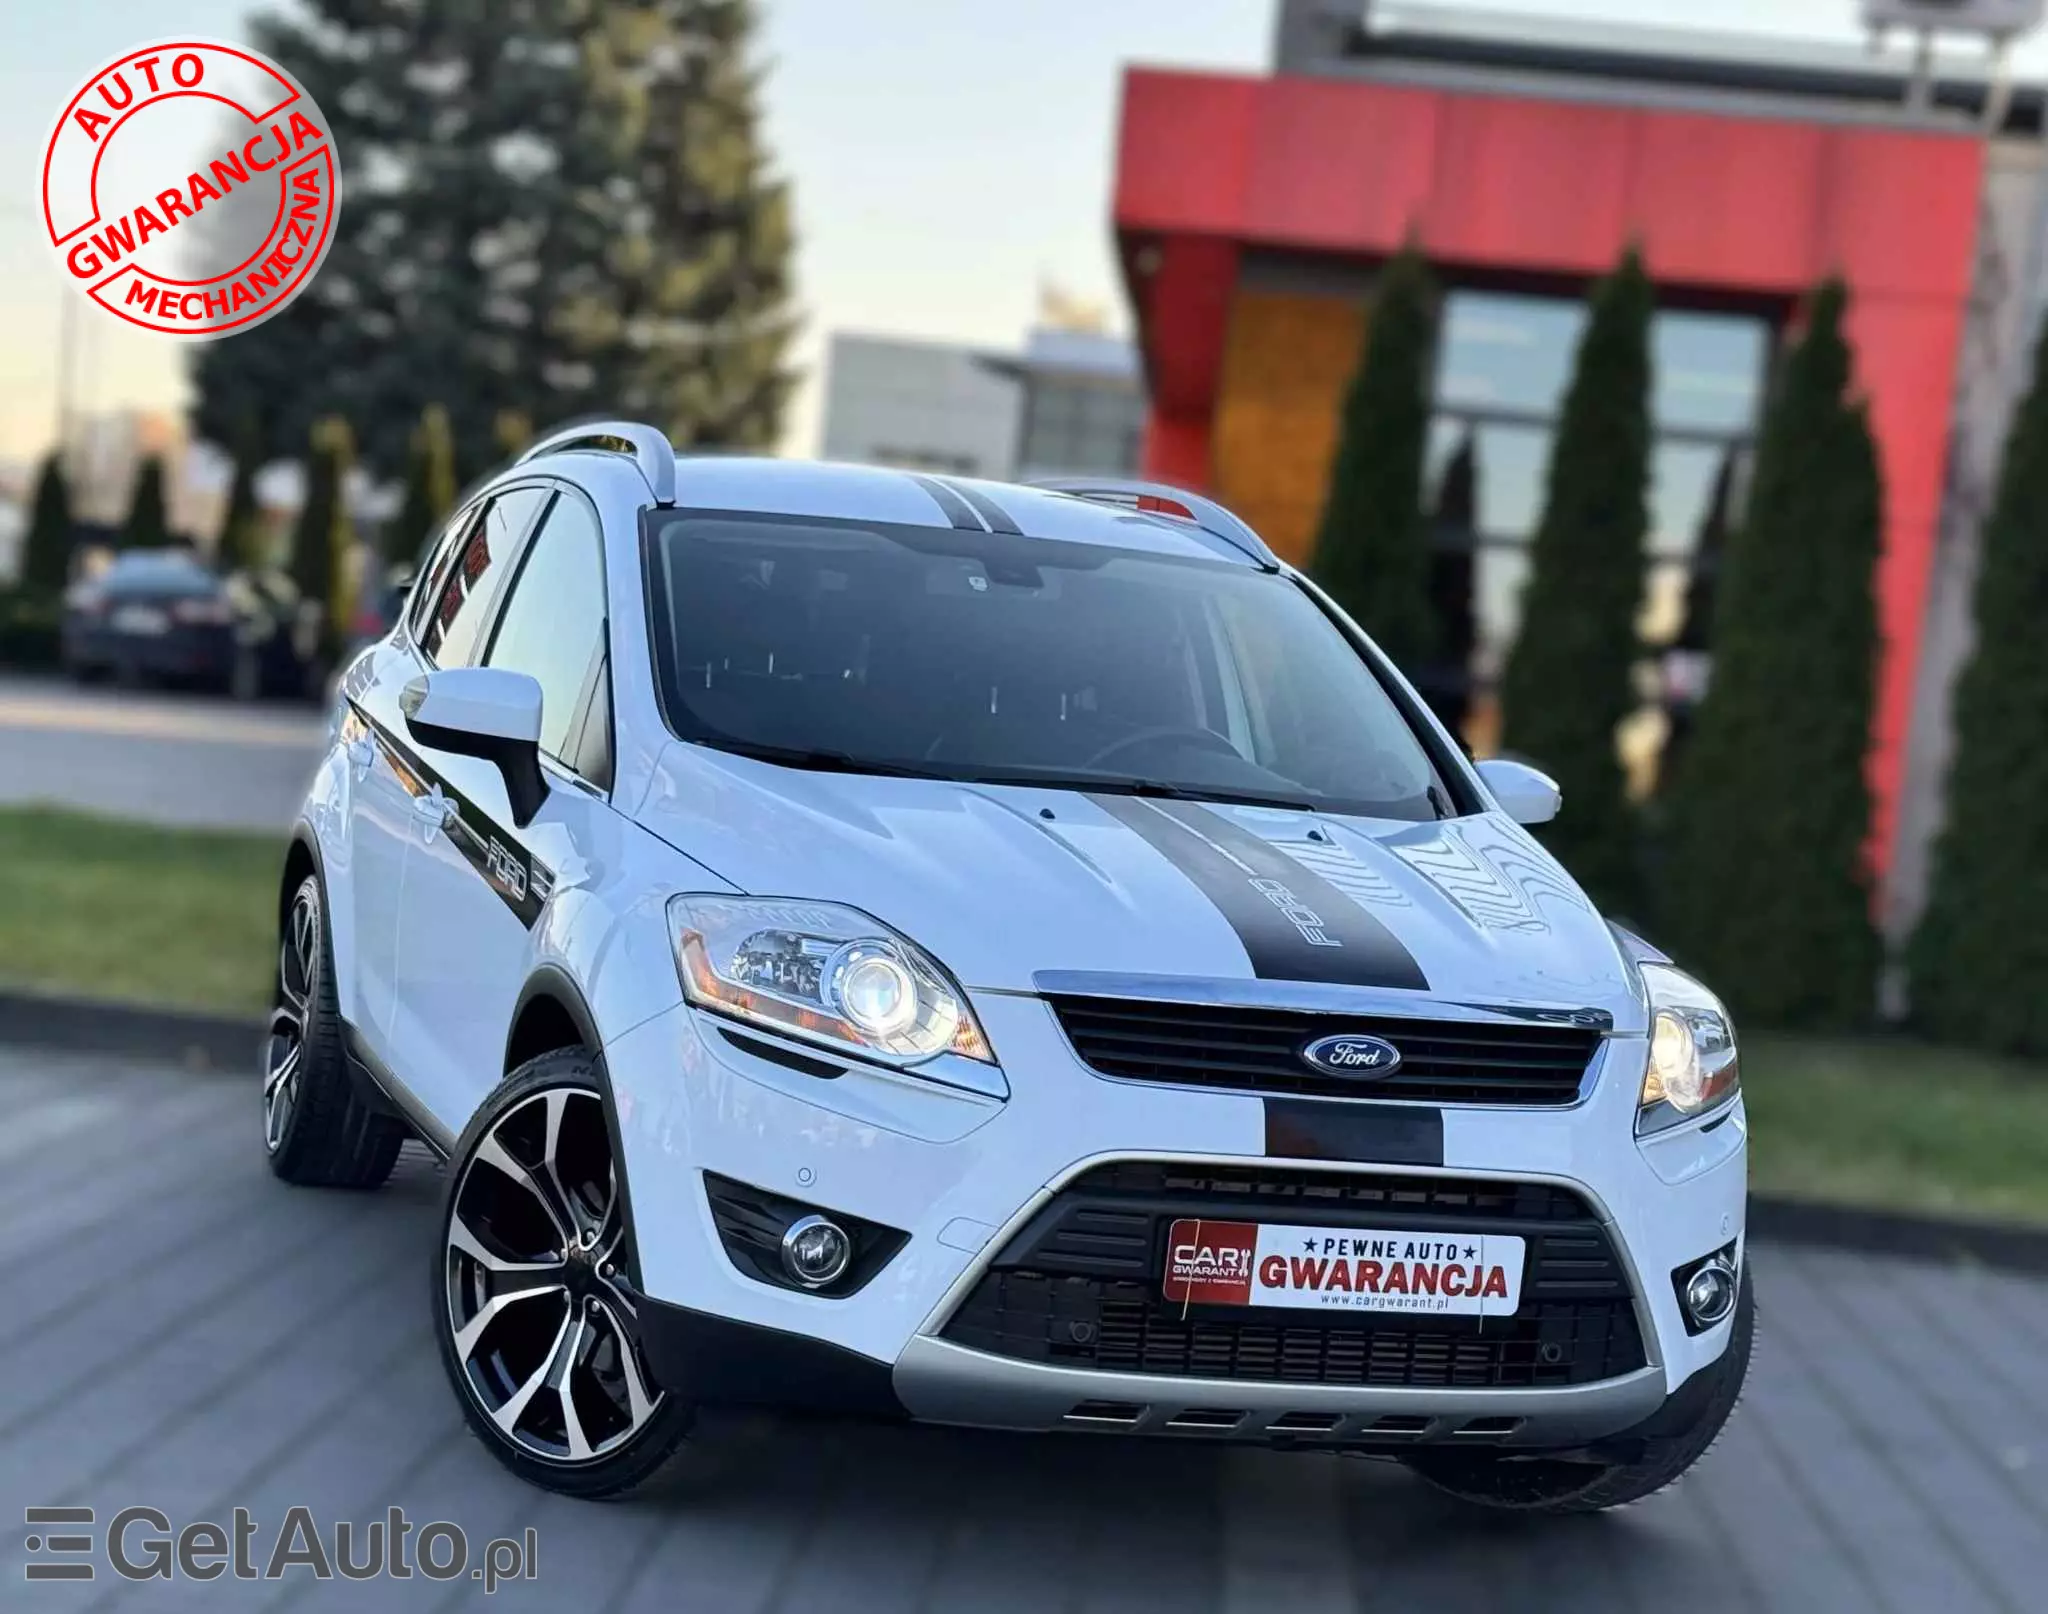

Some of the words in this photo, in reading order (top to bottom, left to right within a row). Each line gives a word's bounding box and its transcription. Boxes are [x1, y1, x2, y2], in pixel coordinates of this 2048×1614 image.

[486, 836, 527, 901] FORD
[1248, 878, 1343, 947] FORD
[1329, 1042, 1381, 1065] Ford
[1174, 1245, 1239, 1267] CAR
[1323, 1238, 1397, 1258] PEWNE
[1404, 1241, 1458, 1260] AUTO
[1172, 1265, 1238, 1277] GWARANT
[1259, 1255, 1508, 1298] GWARANCJA
[1320, 1293, 1449, 1309] www.cargwarant.pl
